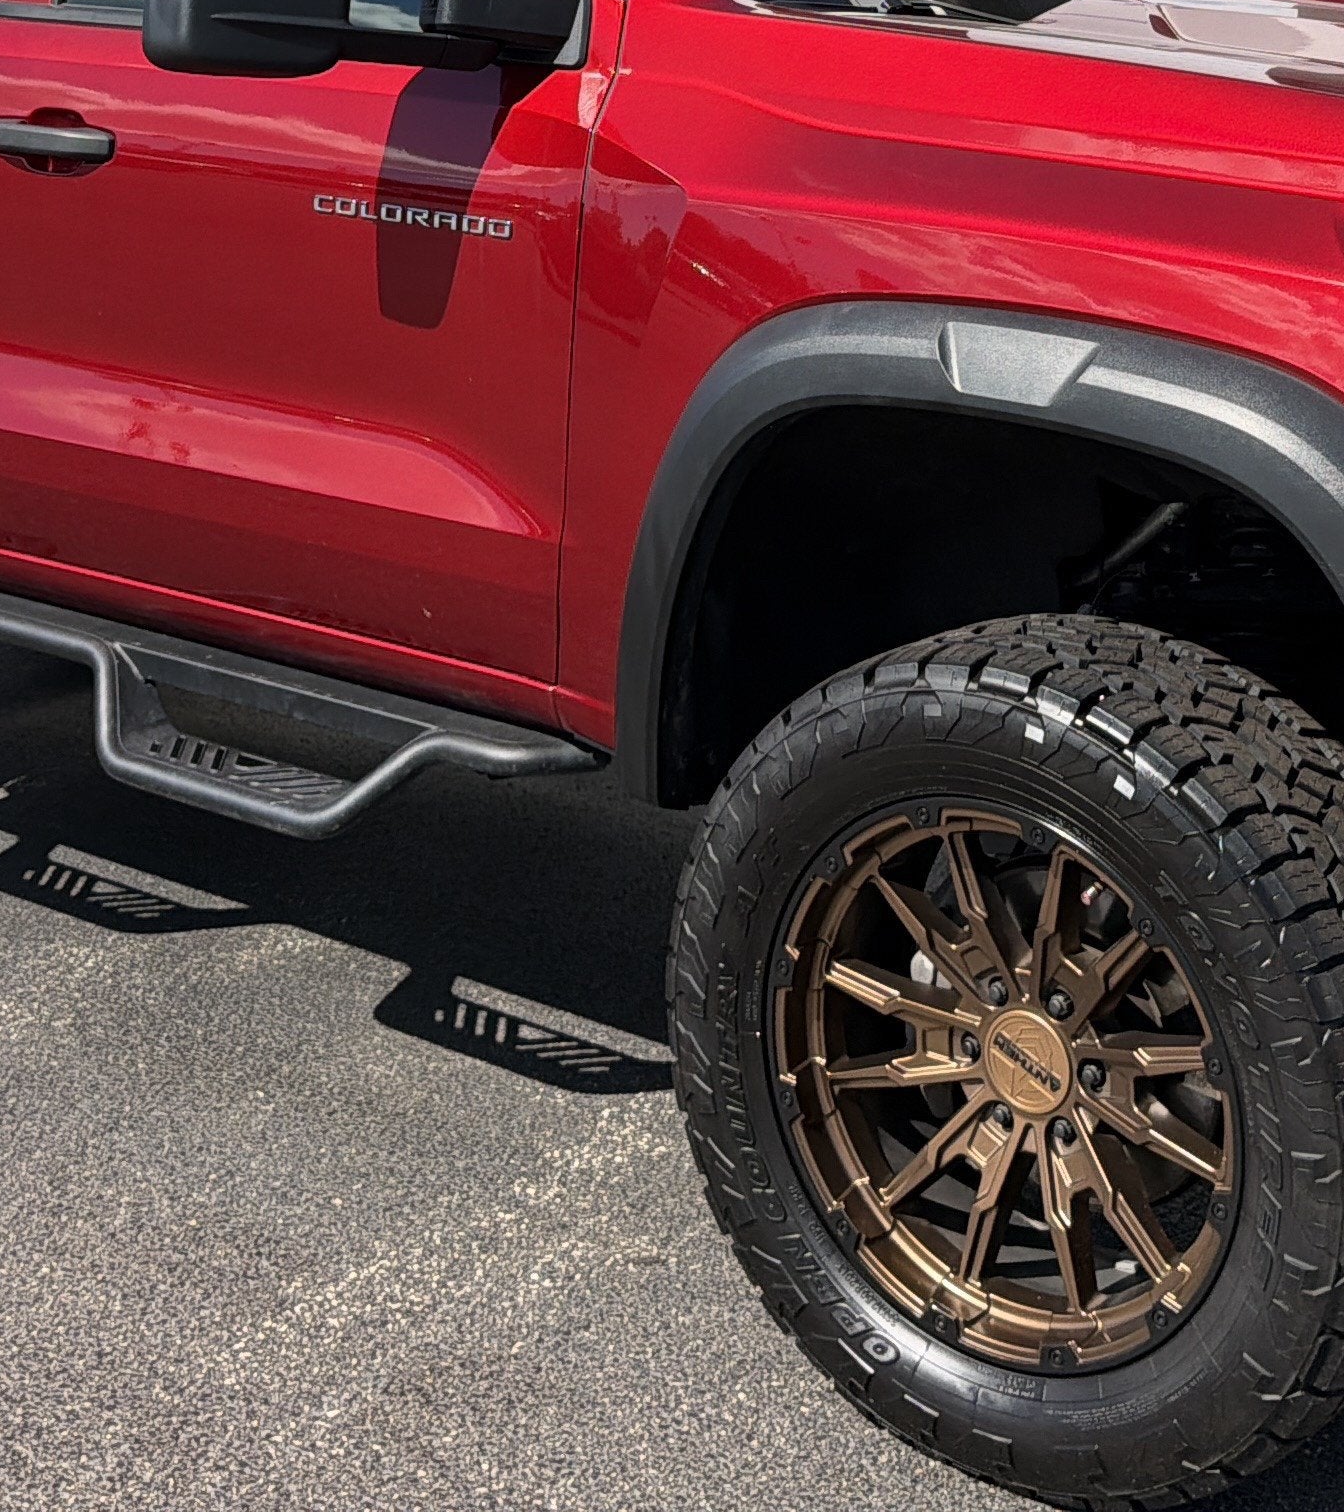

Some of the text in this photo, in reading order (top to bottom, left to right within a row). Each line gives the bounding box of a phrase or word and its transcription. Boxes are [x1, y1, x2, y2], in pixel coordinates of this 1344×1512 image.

[312, 193, 514, 239] COLORADO
[1157, 869, 1283, 1294] TOYO TIRES
[777, 1233, 902, 1365] OPEN
